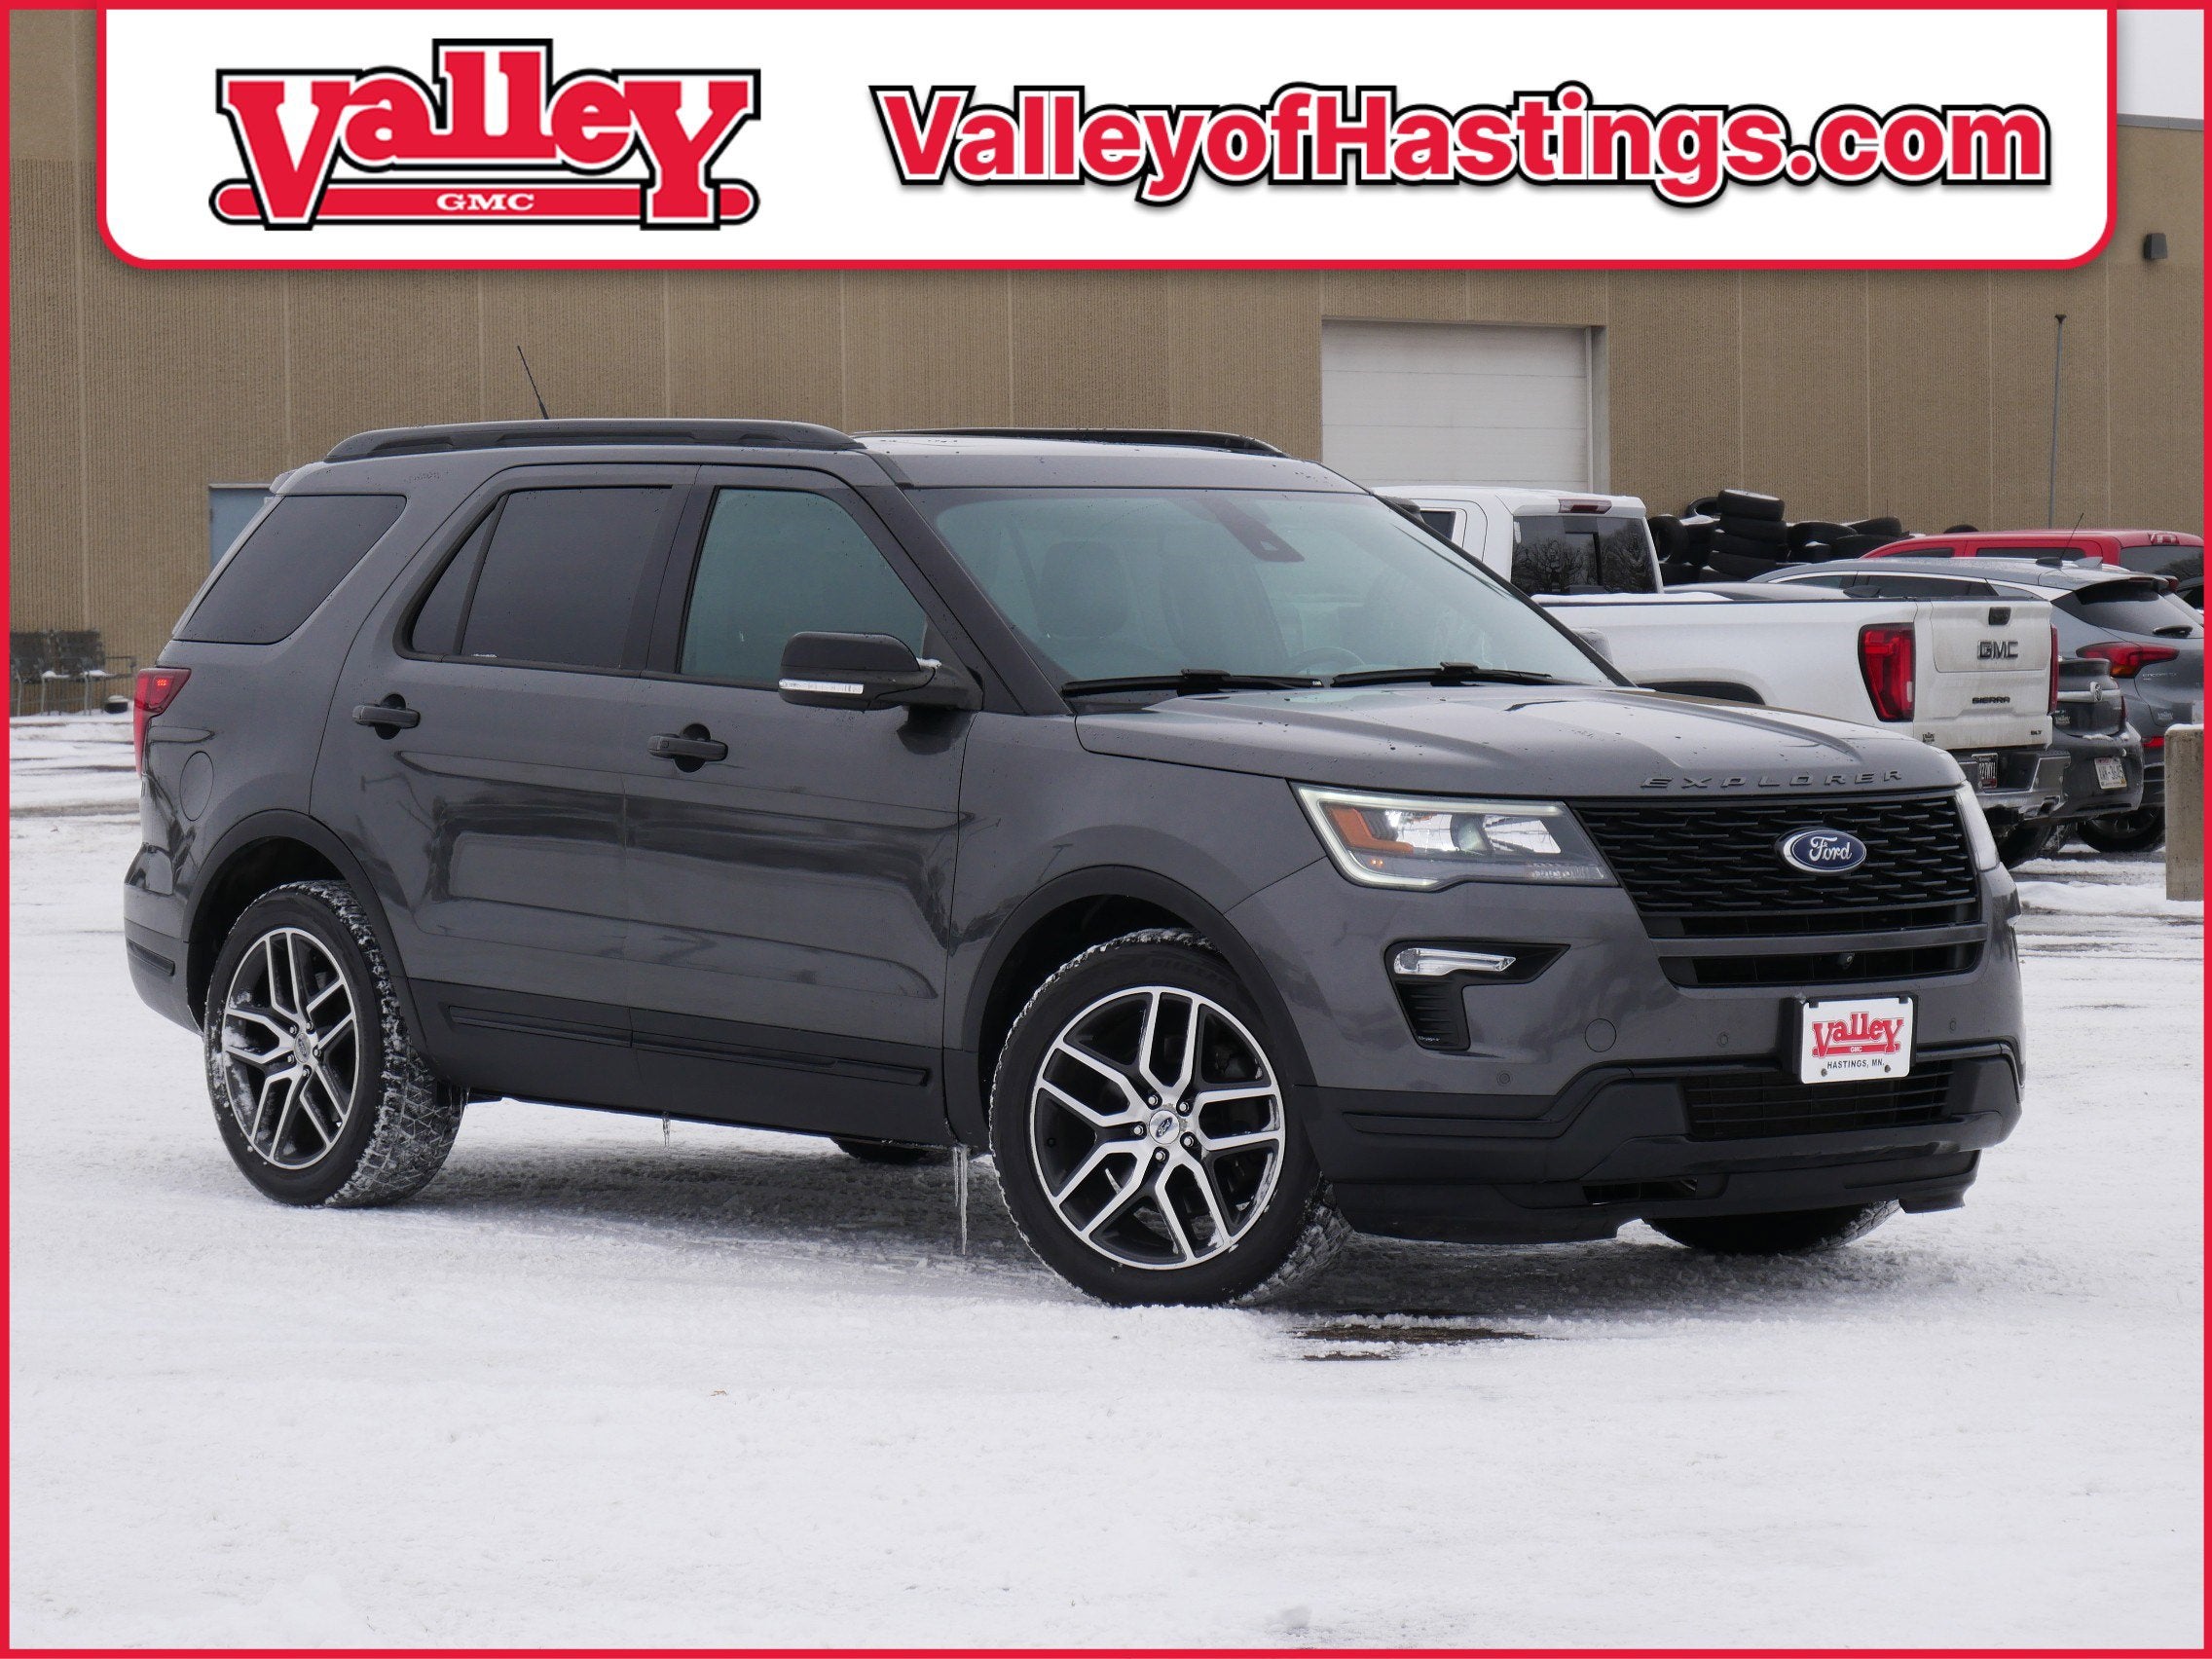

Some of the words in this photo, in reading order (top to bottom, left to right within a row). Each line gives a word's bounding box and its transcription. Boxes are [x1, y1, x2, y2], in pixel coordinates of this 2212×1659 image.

[1977, 641, 2019, 660] GMC
[1640, 770, 1902, 789] EXPLORER
[1809, 836, 1854, 862] Ford
[1812, 1012, 1904, 1059] Valley
[1826, 1059, 1869, 1070] HASTINGS,
[1871, 1058, 1885, 1067] MN.
